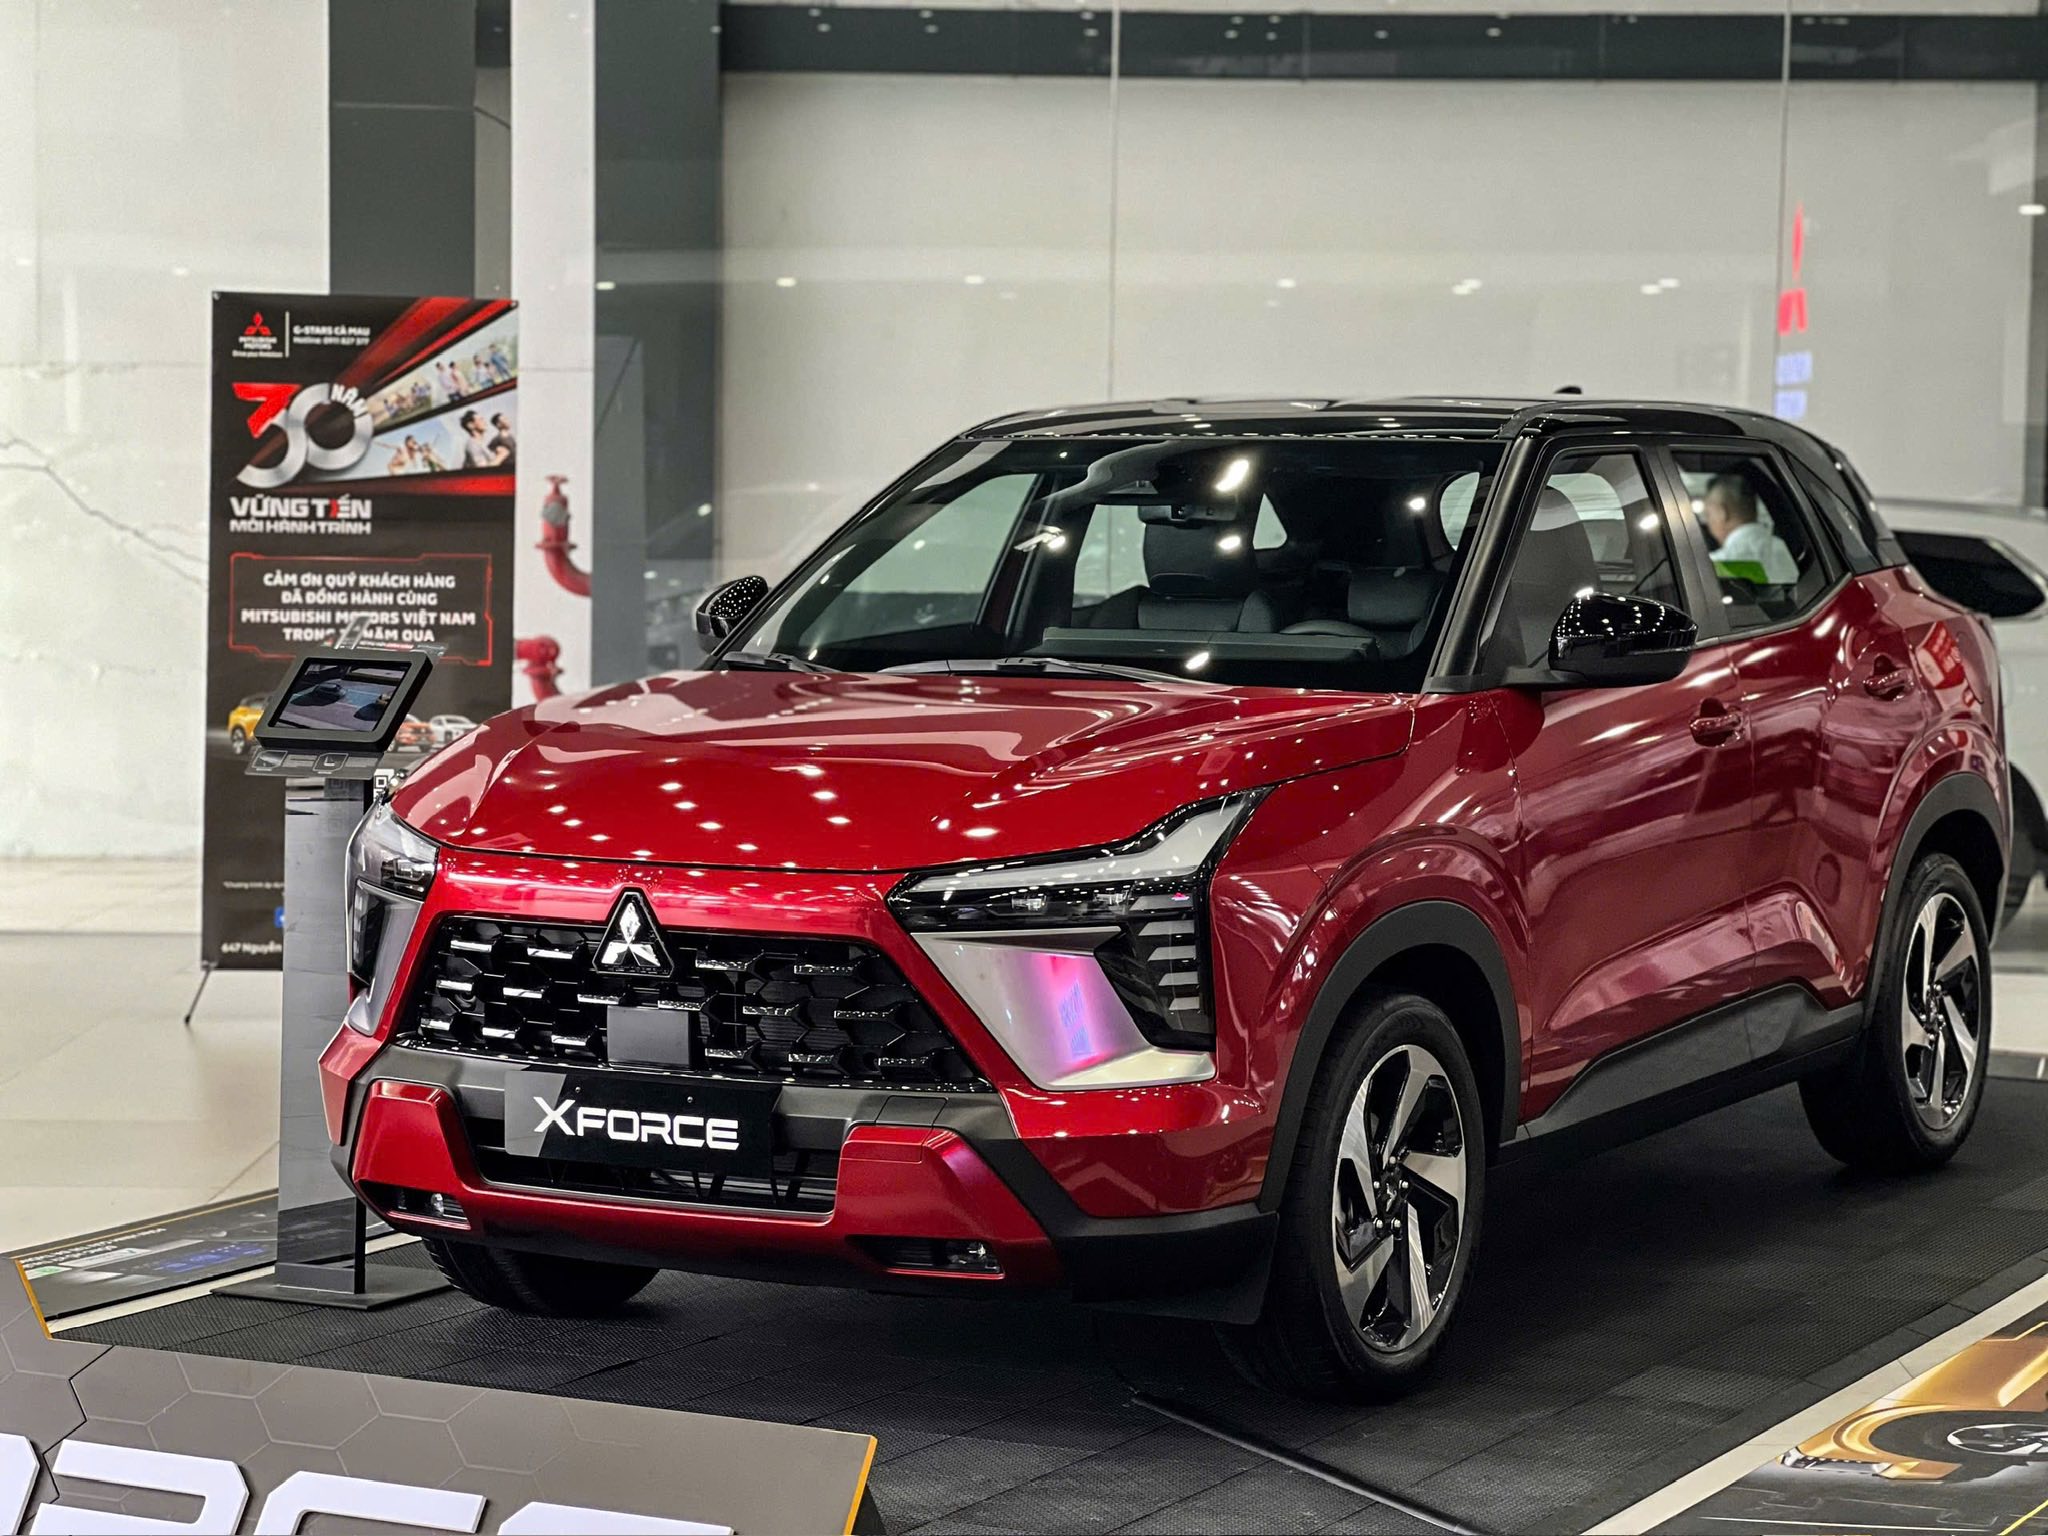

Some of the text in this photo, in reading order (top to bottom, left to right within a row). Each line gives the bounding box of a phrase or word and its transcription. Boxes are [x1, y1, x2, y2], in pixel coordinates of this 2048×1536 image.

[358, 571, 410, 588] KHÁCH
[413, 571, 456, 589] HÀNG
[350, 588, 394, 605] HÀNH
[241, 609, 332, 624] MITSUBISHI
[402, 608, 437, 628] VIỆT
[440, 612, 476, 625] NAM
[402, 629, 435, 642] QUA
[533, 1096, 740, 1150] XFORCE
